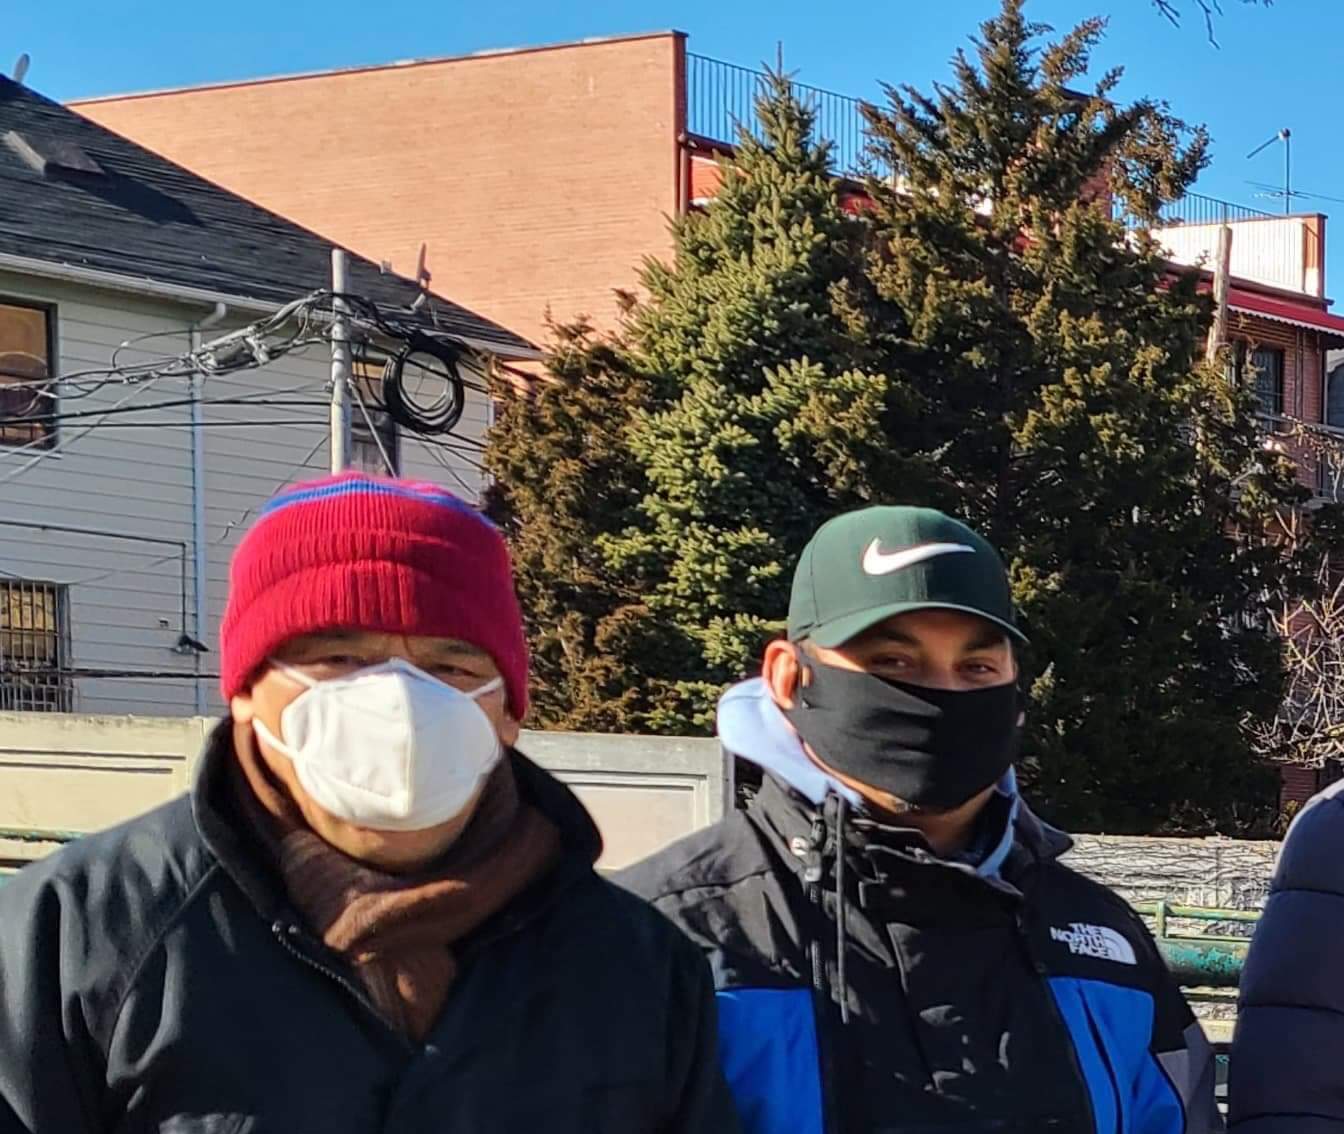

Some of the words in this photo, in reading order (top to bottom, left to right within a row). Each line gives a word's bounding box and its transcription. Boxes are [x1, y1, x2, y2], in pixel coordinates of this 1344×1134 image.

[1049, 926, 1105, 949] NORTH
[1068, 922, 1102, 936] THE
[1068, 940, 1112, 961] FACE
